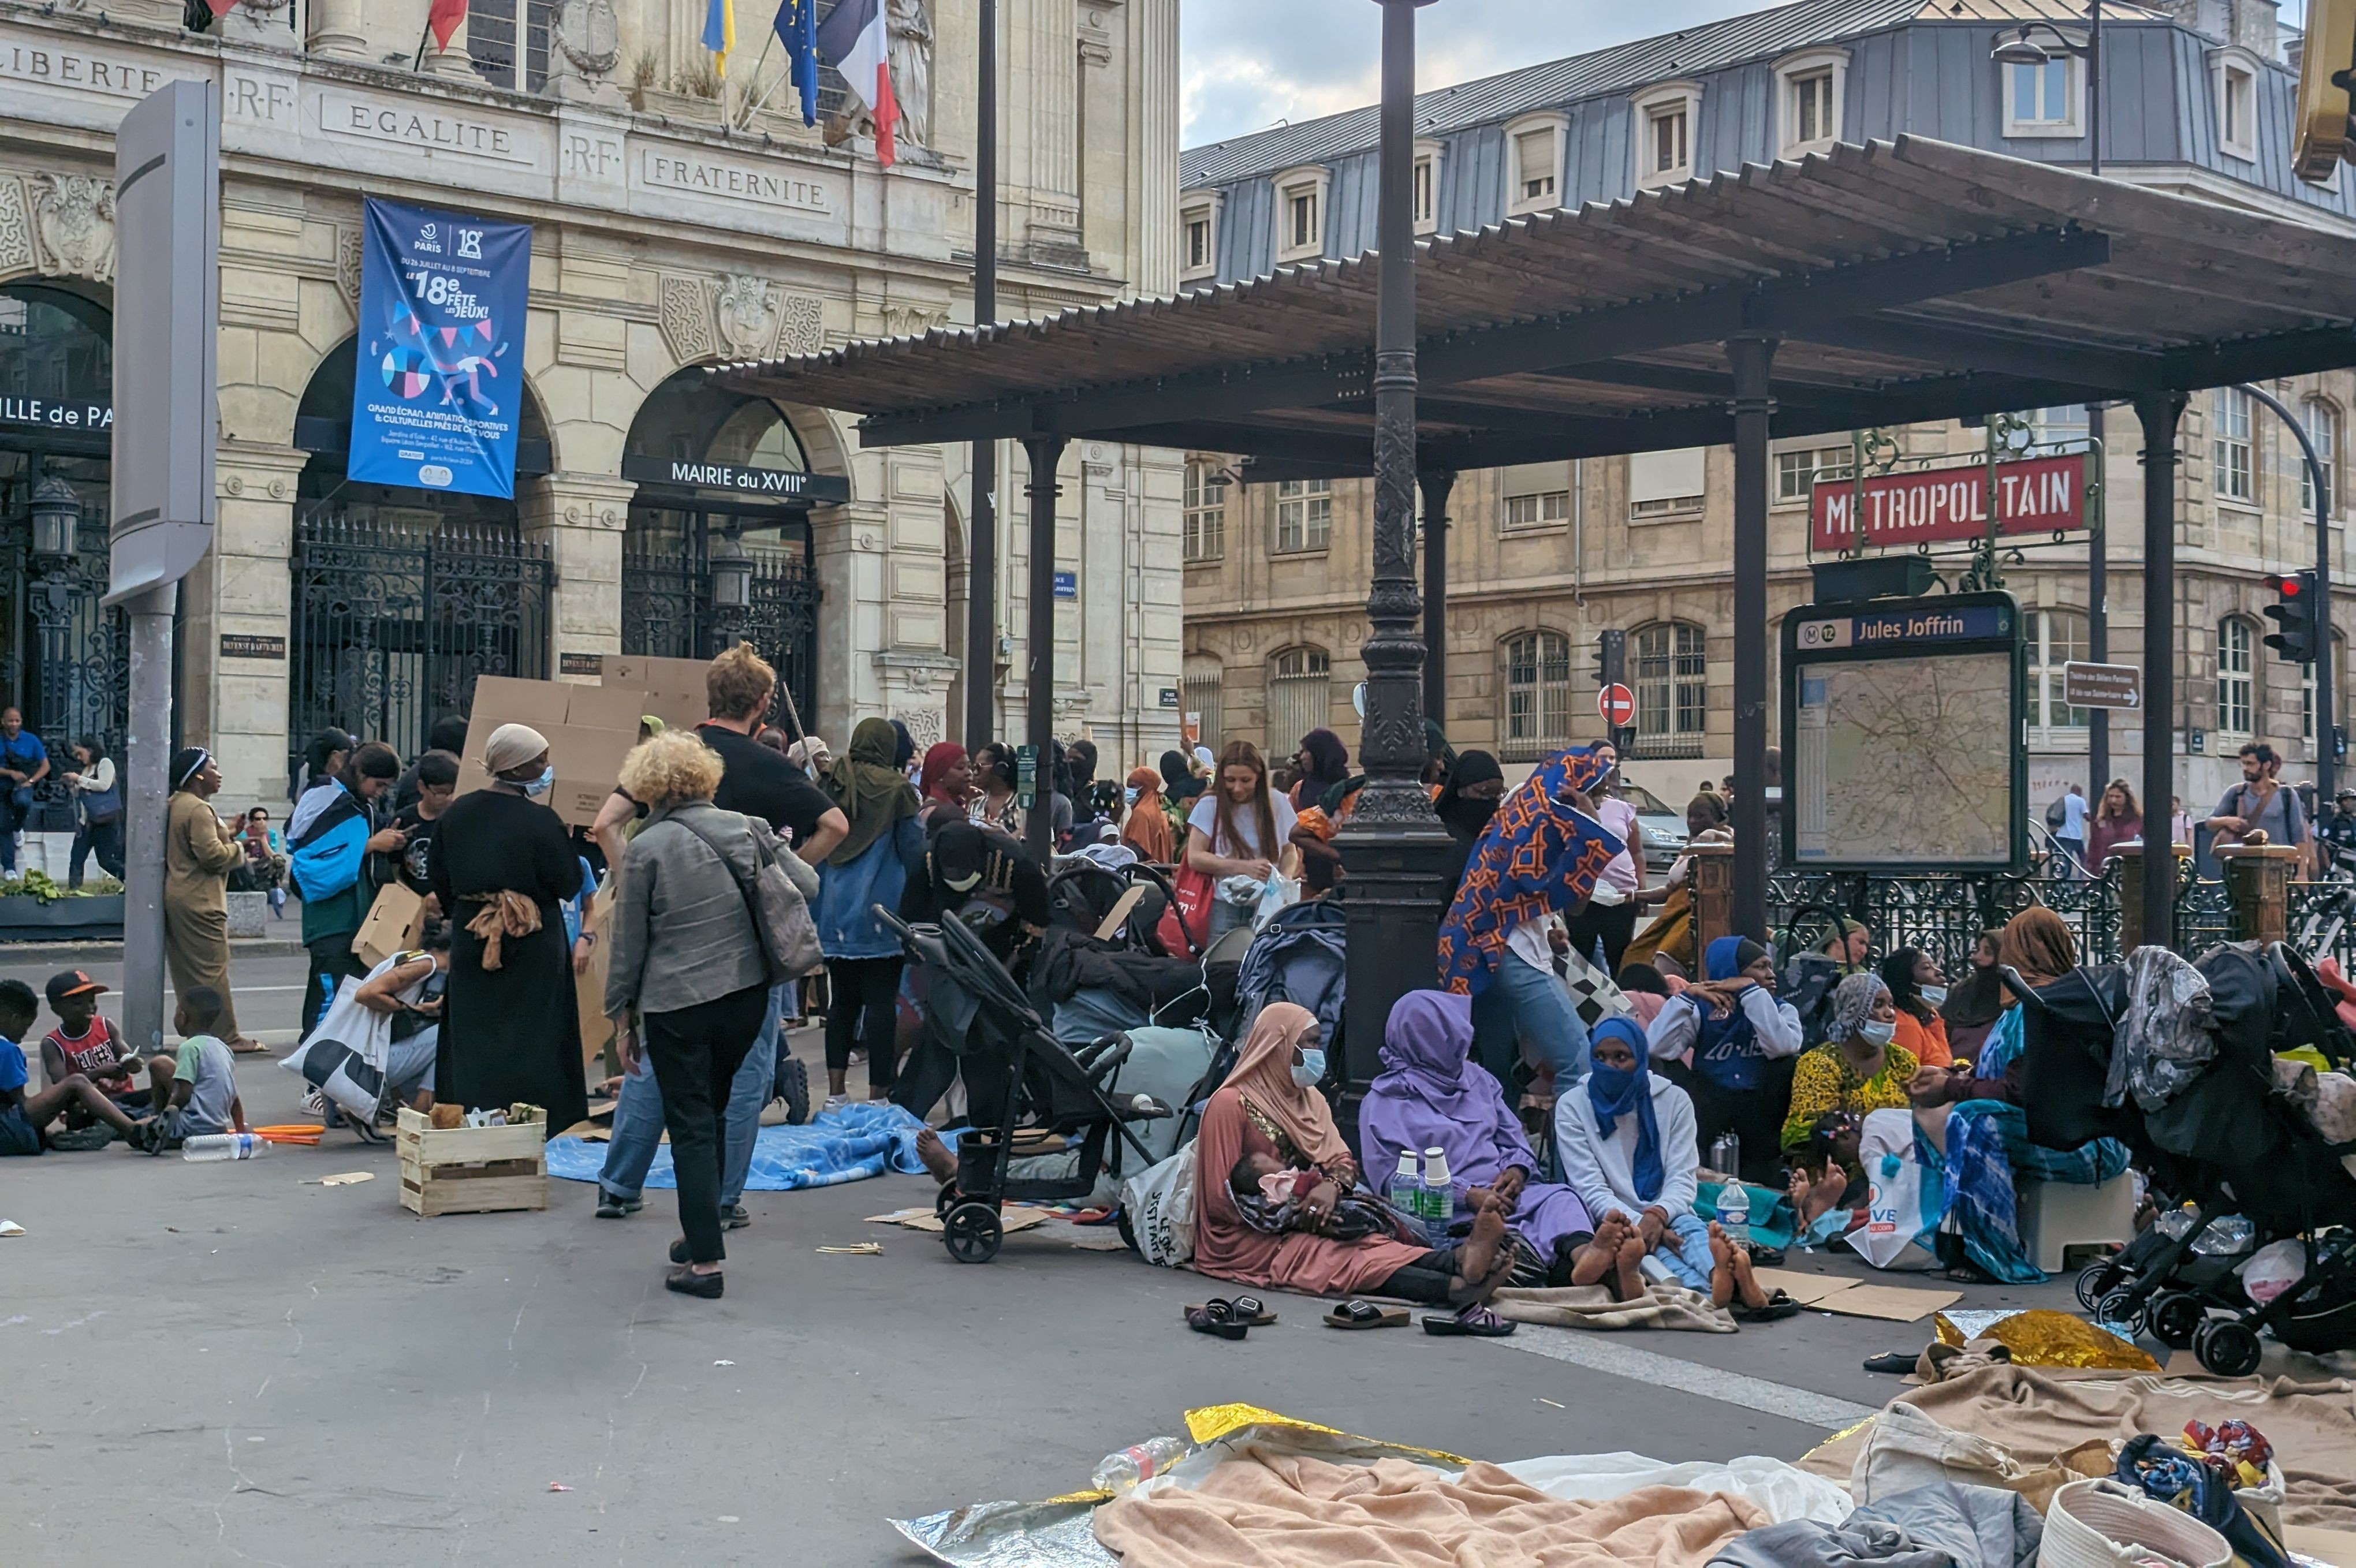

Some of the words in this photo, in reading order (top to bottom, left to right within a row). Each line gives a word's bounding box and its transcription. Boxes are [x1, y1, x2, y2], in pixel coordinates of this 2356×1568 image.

[0, 47, 162, 92] IBERTE
[351, 105, 510, 154] EGALITE
[655, 158, 825, 206] FRATERNITE
[414, 241, 441, 253] PARIS
[419, 260, 441, 269] JUILLET
[456, 266, 491, 278] SEPTEMBRE
[446, 290, 477, 307] FÊTE
[454, 306, 489, 318] JEUX!
[49, 406, 79, 424] de
[368, 404, 396, 415] GRAND
[383, 415, 433, 428] CULTURELLES
[453, 424, 461, 432] DE
[478, 430, 500, 439] VOUS
[672, 462, 732, 486] MAIRIE
[737, 473, 758, 488] du
[1822, 626, 1835, 640] 12
[1859, 621, 1901, 640] Jules
[1906, 615, 1963, 637] Joffrin
[1869, 1209, 1897, 1222] VE
